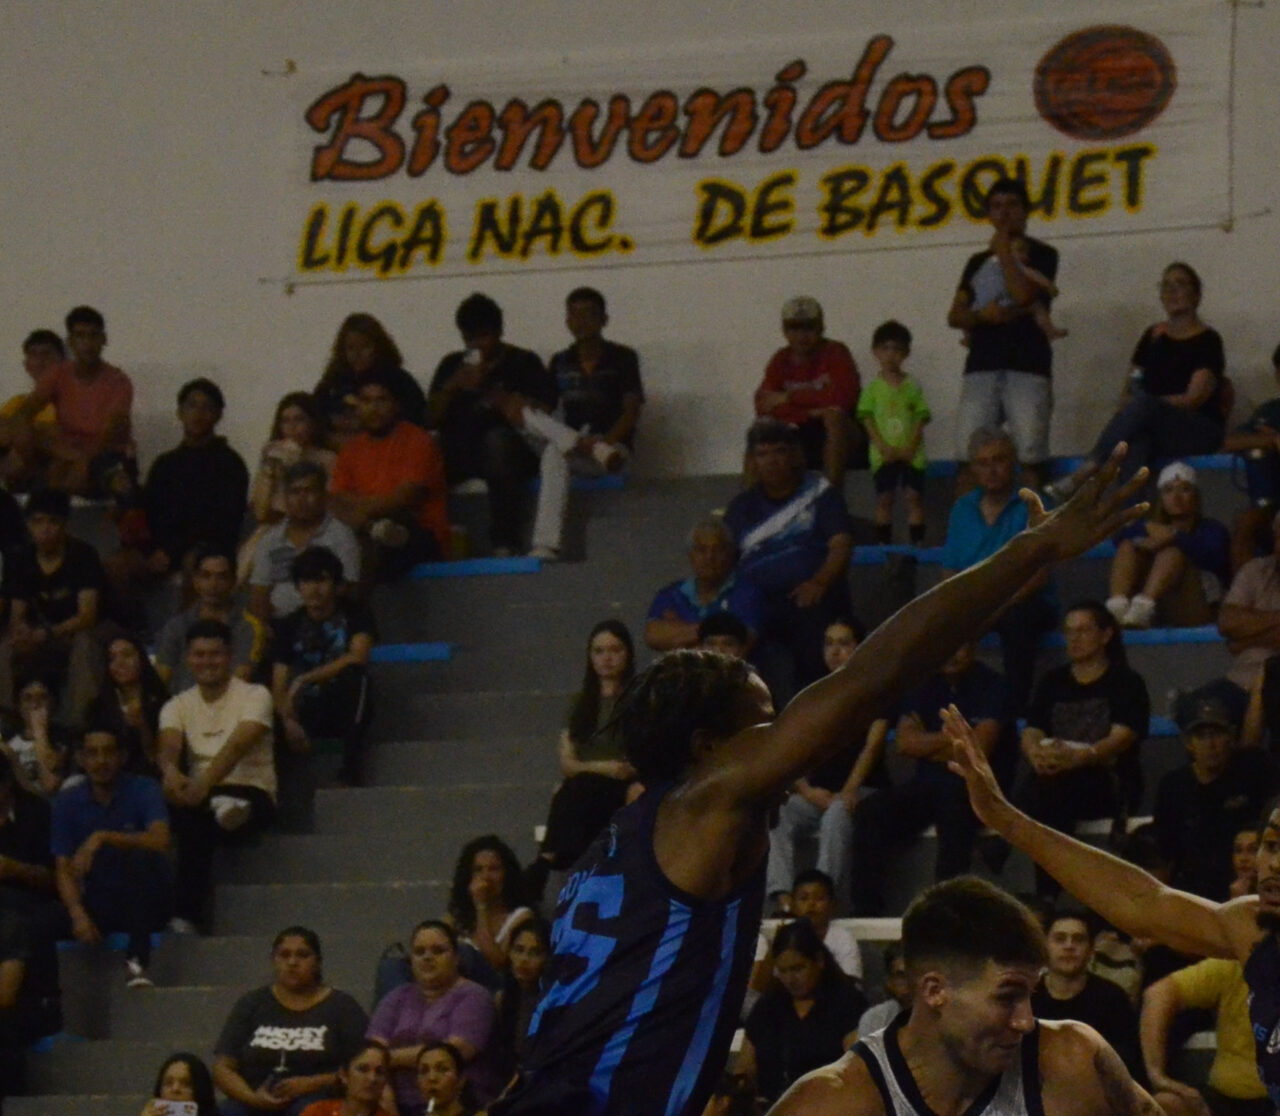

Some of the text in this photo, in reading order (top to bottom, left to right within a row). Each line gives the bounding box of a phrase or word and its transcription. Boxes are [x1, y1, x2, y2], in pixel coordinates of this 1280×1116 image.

[305, 34, 990, 181] Bienvenidos
[301, 142, 1157, 276] LIGA NAC. DE BASQUET
